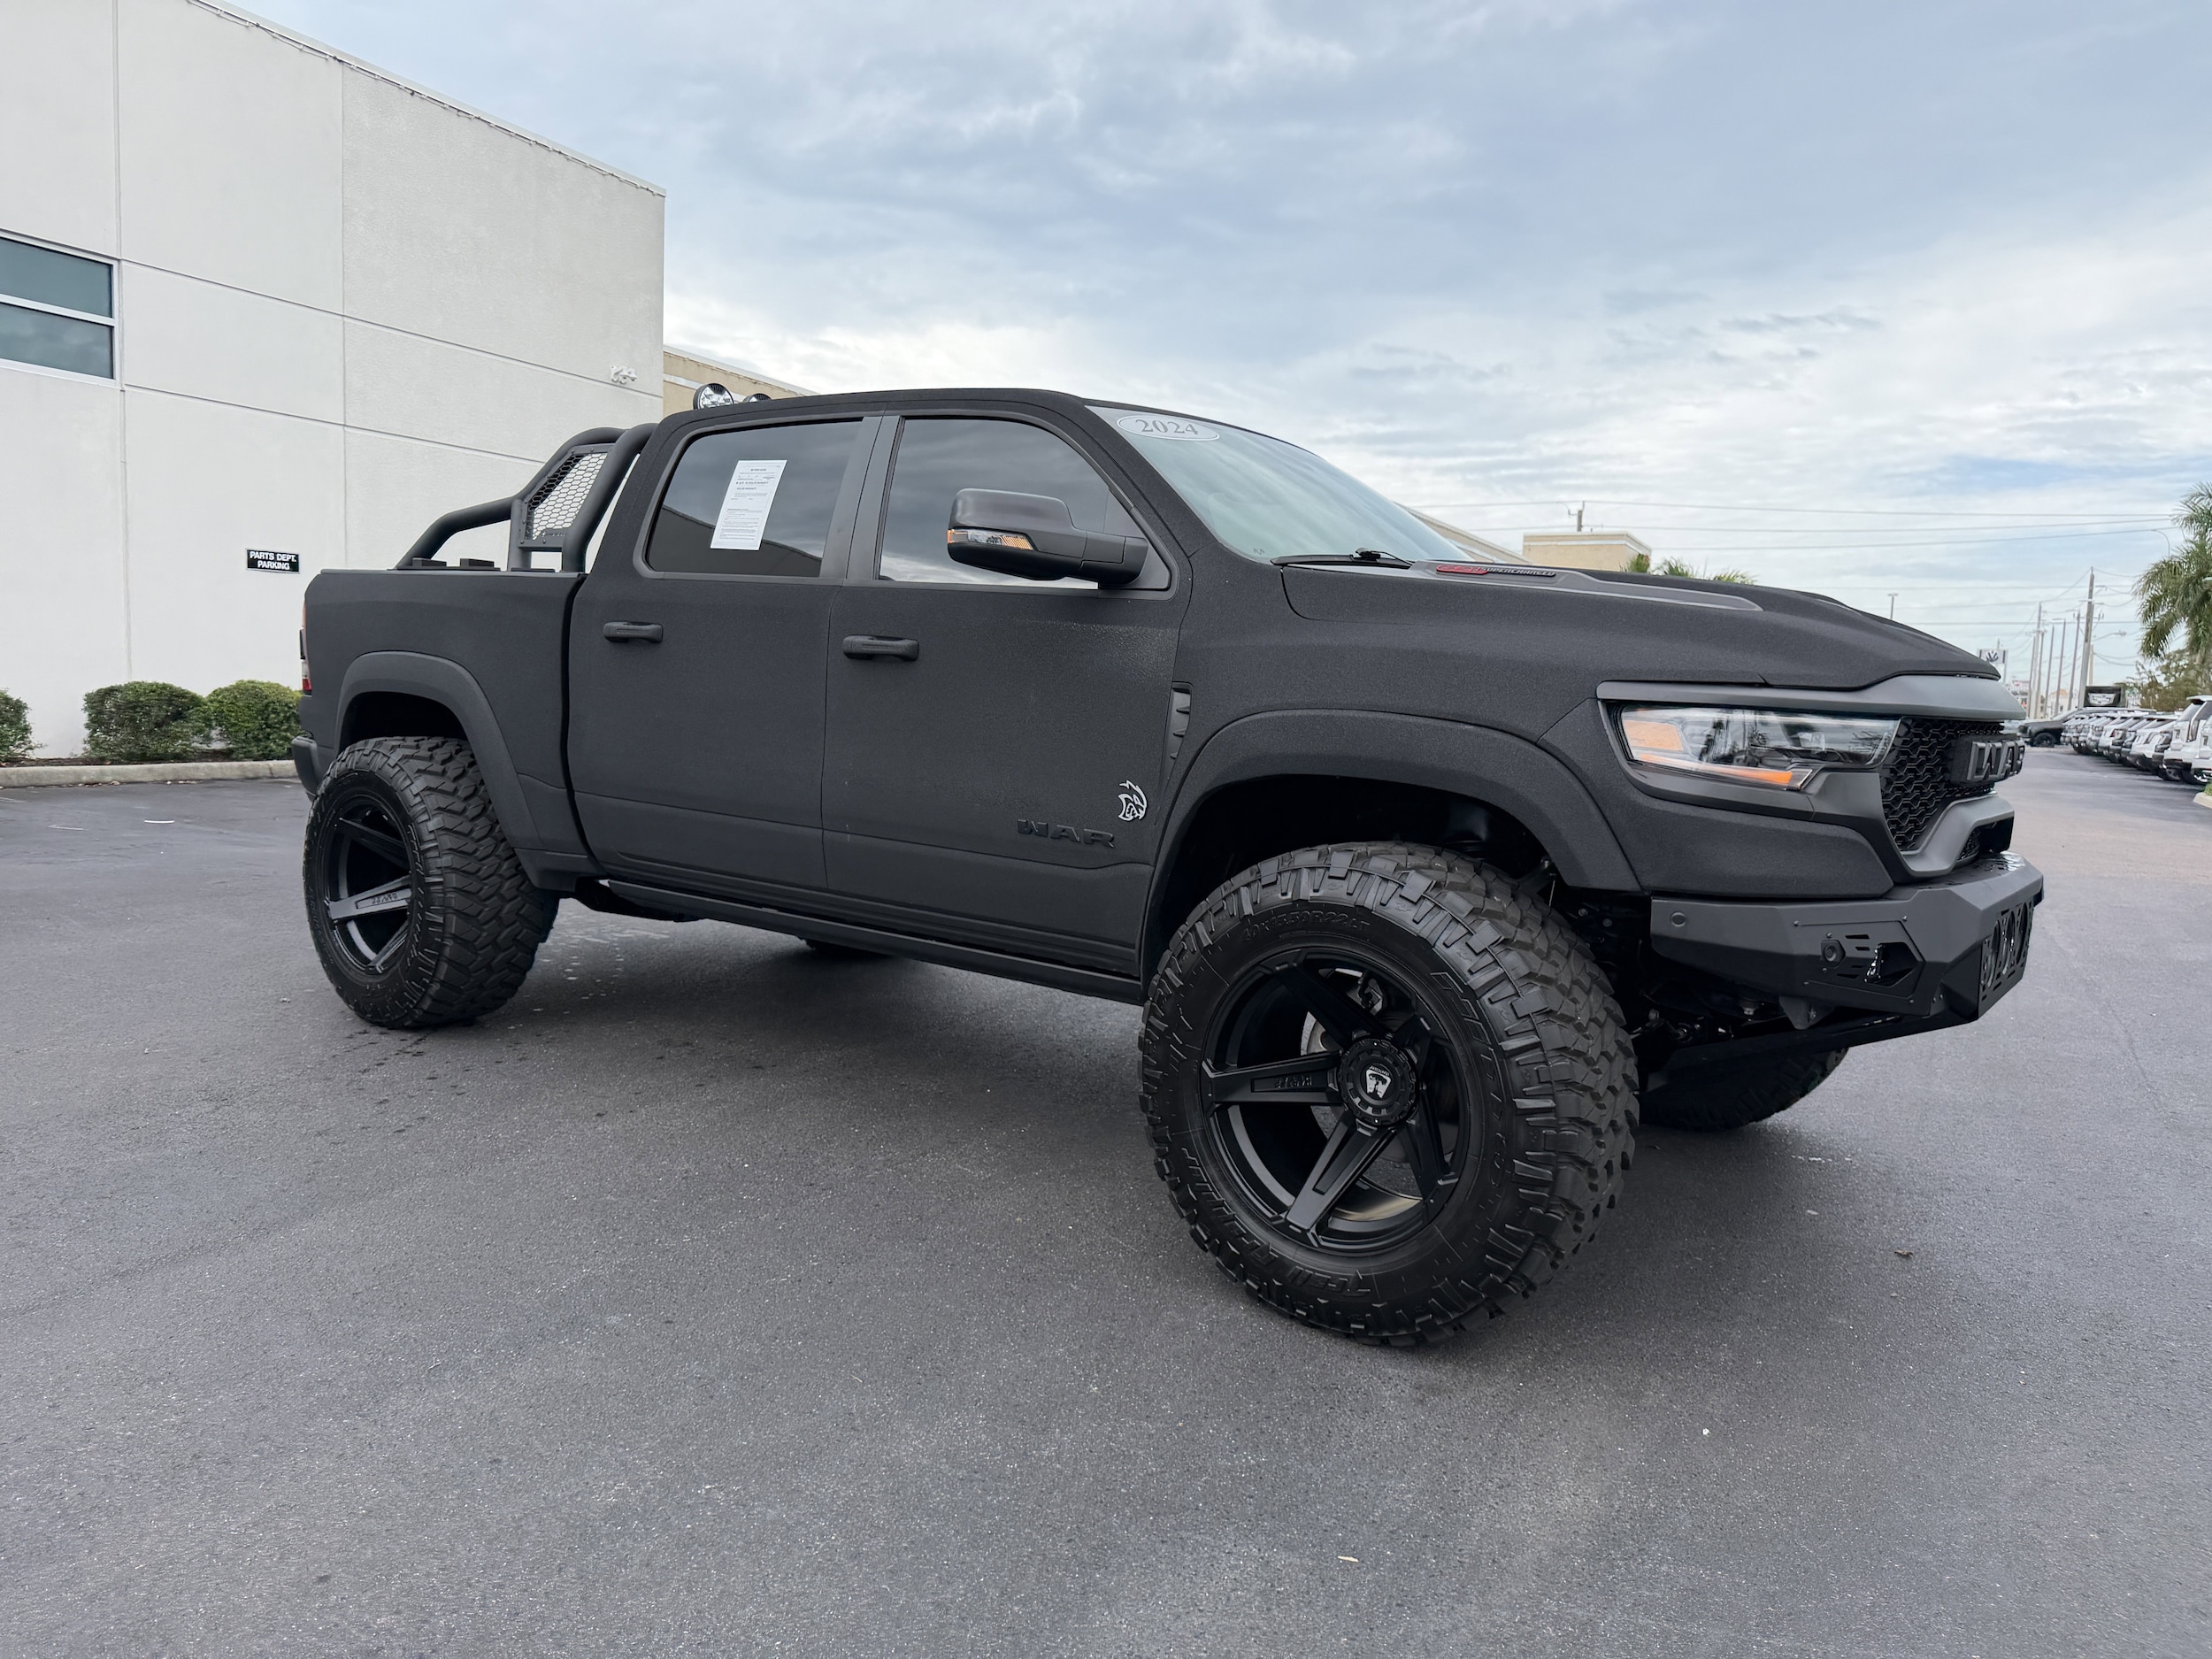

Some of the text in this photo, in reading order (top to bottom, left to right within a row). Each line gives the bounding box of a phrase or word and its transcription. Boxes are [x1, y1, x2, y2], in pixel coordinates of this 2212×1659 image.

[1135, 419, 1199, 435] 2024
[250, 550, 296, 562] PARTS DEPT.
[257, 560, 290, 570] PARKING
[1017, 818, 1116, 849] WAR
